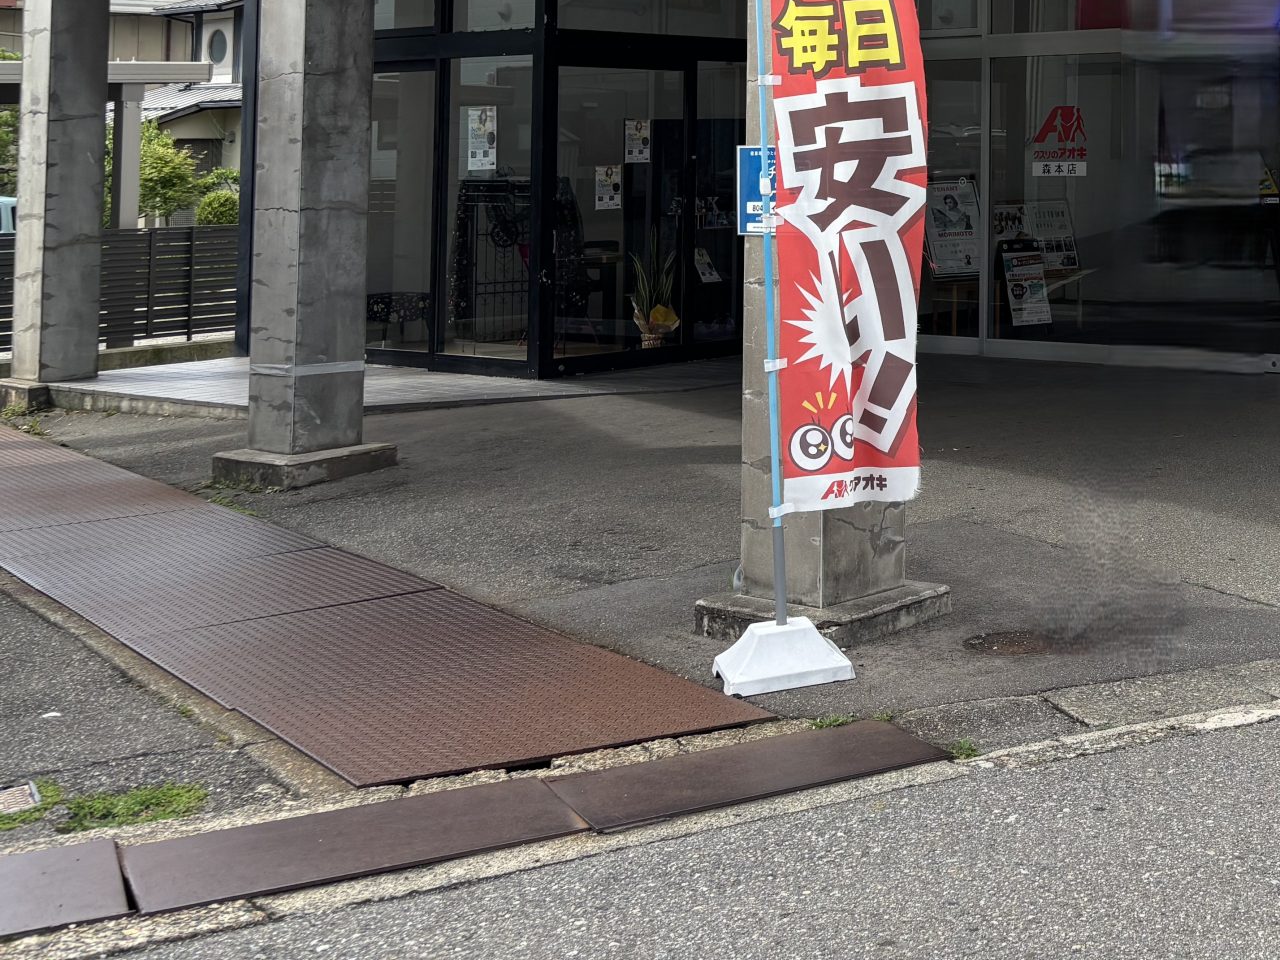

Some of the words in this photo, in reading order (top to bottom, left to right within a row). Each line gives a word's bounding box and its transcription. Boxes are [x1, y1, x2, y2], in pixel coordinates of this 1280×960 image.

[1033, 147, 1088, 159] クスリのアオキ
[1042, 163, 1077, 175] 森本店
